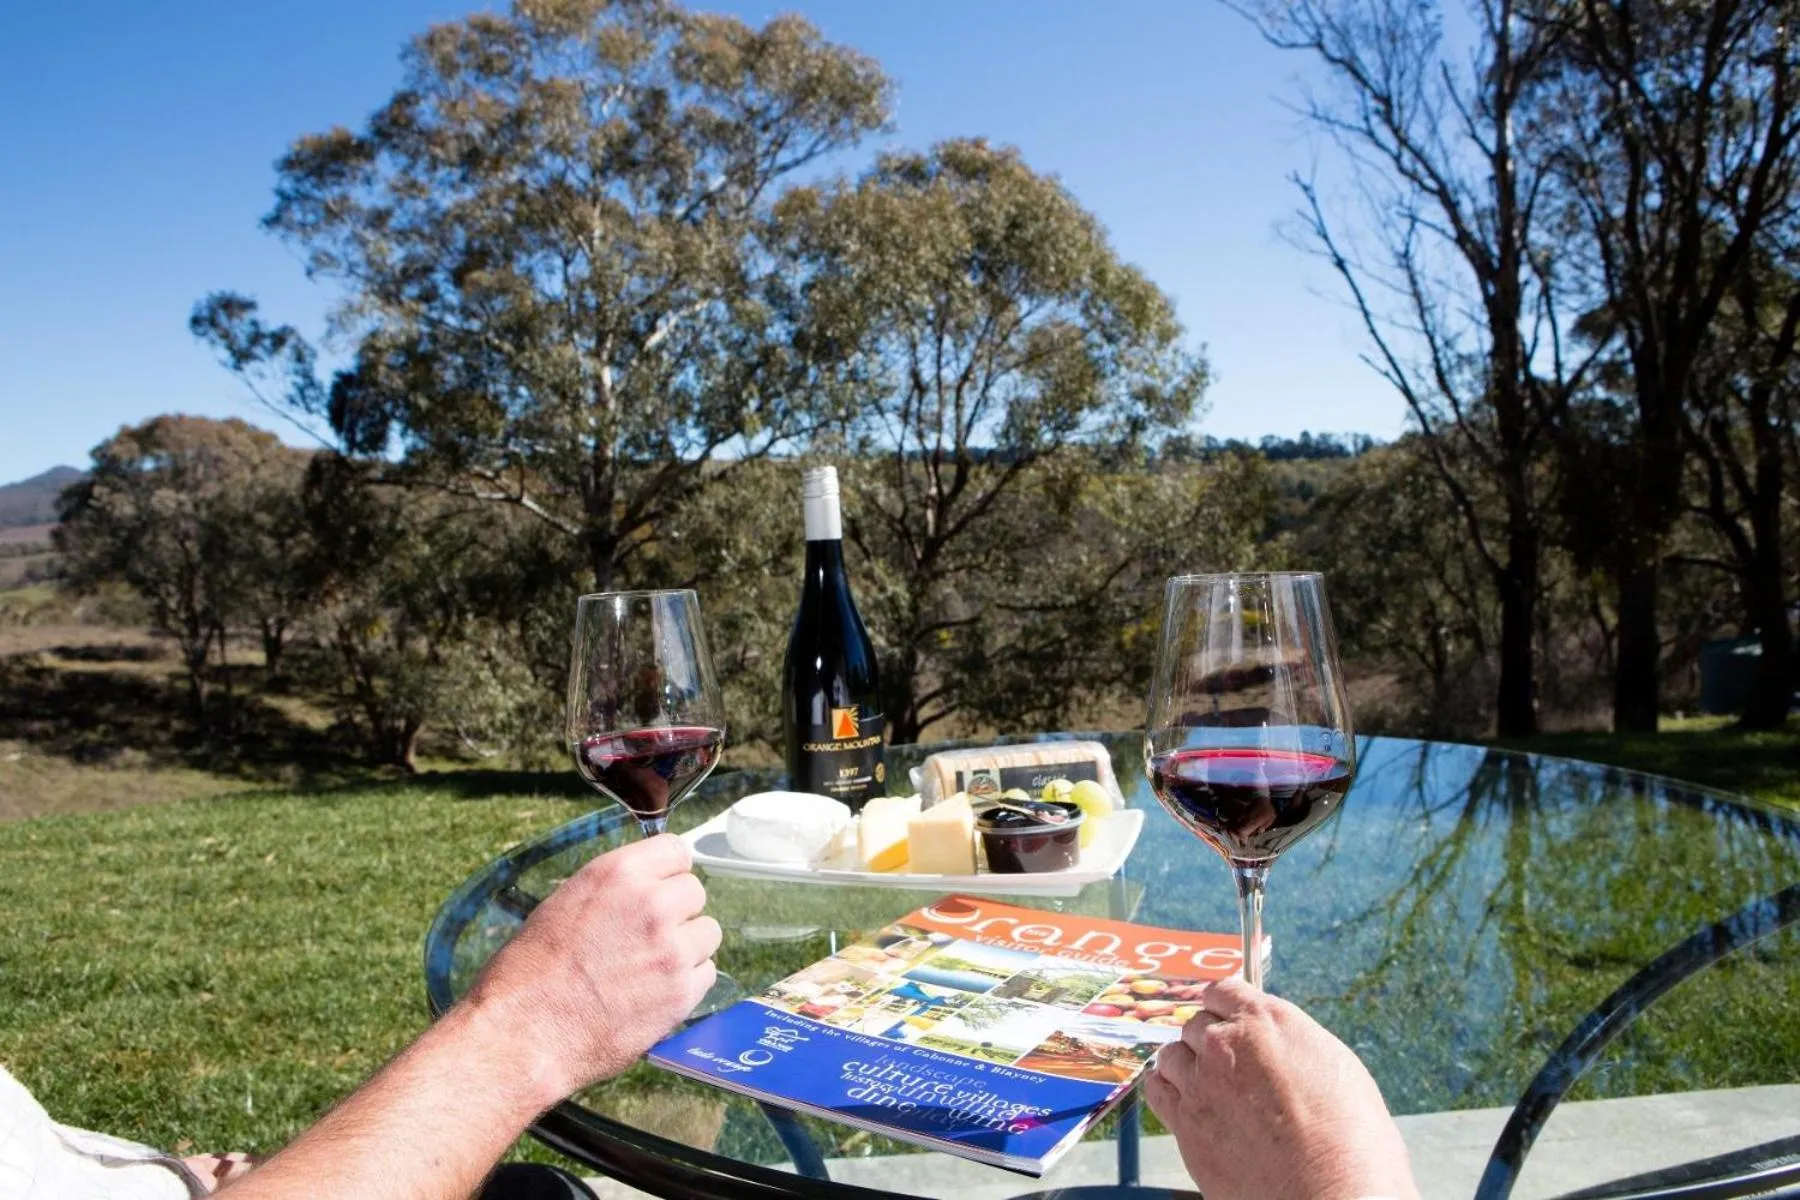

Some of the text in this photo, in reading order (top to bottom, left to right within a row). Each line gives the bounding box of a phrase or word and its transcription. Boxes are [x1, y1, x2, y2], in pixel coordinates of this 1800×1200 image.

[803, 742, 842, 752] ORANGE
[764, 1010, 818, 1031] Including
[822, 1028, 841, 1037] the
[845, 1035, 889, 1048] villages
[894, 1045, 909, 1053] of
[912, 1049, 970, 1067] Cabonne
[974, 1063, 986, 1071] &
[842, 1060, 1052, 1118] culture villages
[875, 1054, 987, 1088] landscape
[847, 1082, 917, 1113] dine
[949, 1107, 1029, 1134] wine
